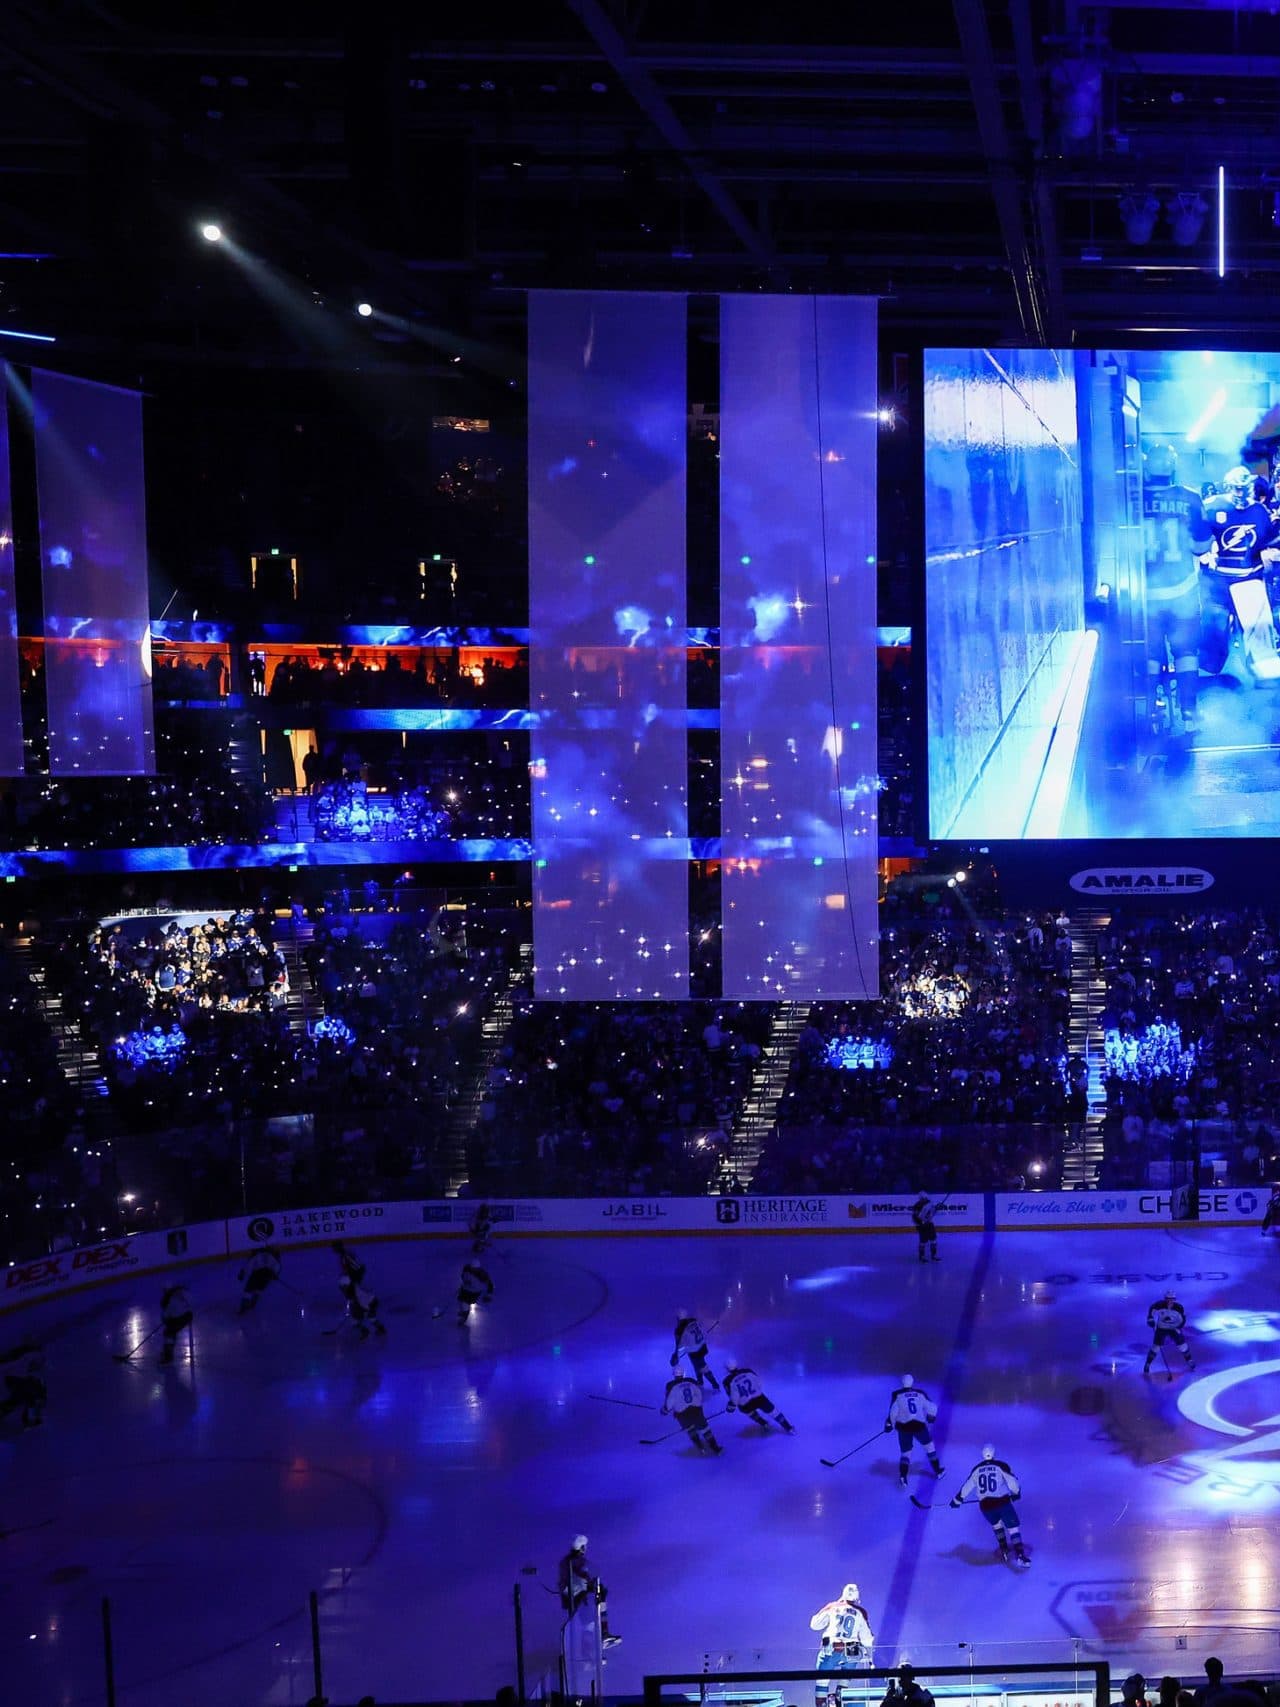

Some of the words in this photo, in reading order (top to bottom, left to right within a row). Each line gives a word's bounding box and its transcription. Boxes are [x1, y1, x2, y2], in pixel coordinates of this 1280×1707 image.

[1081, 875, 1204, 888] AMALIE
[602, 1204, 667, 1217] JABIL
[744, 1199, 828, 1213] HERITAGE
[1008, 1201, 1062, 1216] Florida
[1065, 1200, 1097, 1214] Blue
[282, 1207, 384, 1225] LAKEWOOD
[744, 1212, 828, 1223] INSURANCE
[283, 1222, 347, 1238] RANCH
[6, 1256, 63, 1289] DEX
[72, 1241, 132, 1270] DEX
[683, 1388, 693, 1404] 8
[736, 1379, 757, 1398] 42
[907, 1397, 917, 1415] 6
[978, 1472, 997, 1494] 96
